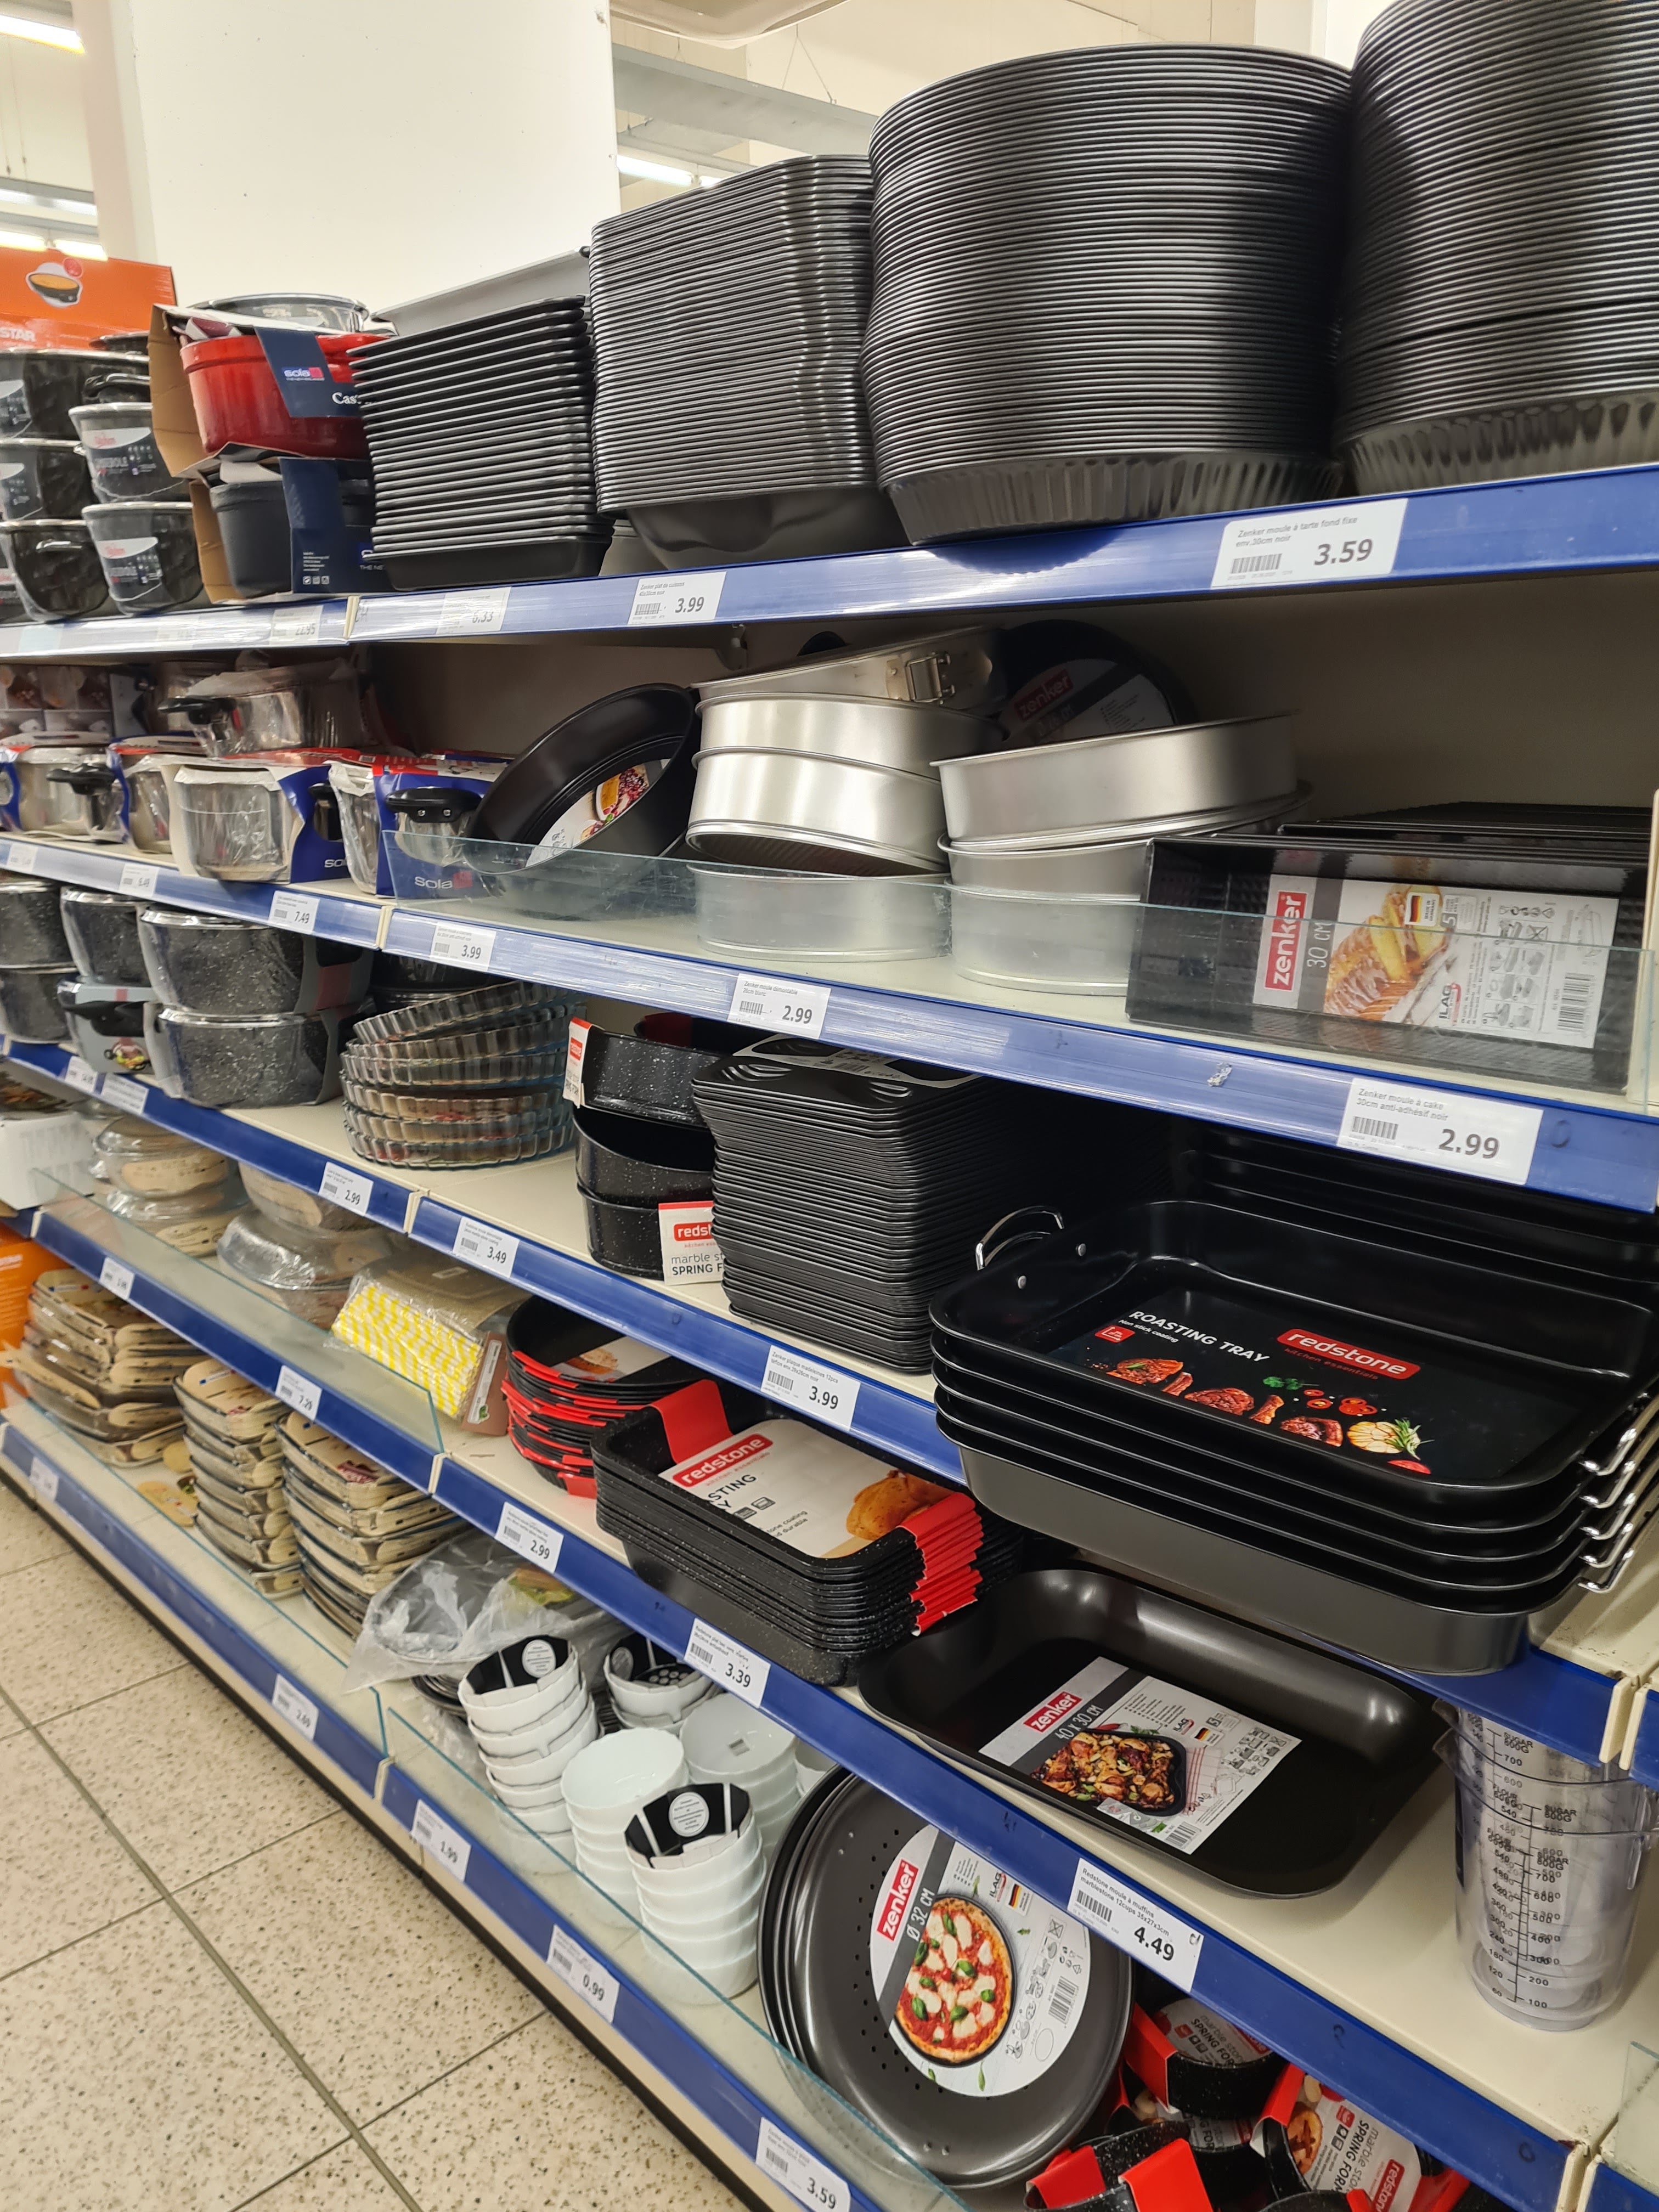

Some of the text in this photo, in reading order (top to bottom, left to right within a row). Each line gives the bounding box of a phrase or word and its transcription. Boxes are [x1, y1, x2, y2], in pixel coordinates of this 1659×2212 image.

[284, 368, 311, 377] sola
[1238, 516, 1358, 538] Zenker moule à tarte fond fixe
[1274, 535, 1291, 543] noir
[1313, 538, 1373, 566] 3.59
[675, 596, 704, 613] 3.99
[1019, 675, 1070, 719] zenker
[415, 876, 453, 890] sola
[1272, 895, 1302, 986] zenker
[1307, 922, 1333, 968] 30 CM
[461, 945, 482, 960] 3.99
[1439, 985, 1453, 1019] ILAG
[782, 1005, 812, 1024] 2.99
[1356, 1098, 1448, 1122] 30cm anti-adhésif noir
[1358, 1088, 1444, 1110] Zenker moule à cake
[1438, 1128, 1500, 1159] 2.99
[345, 1189, 360, 1205] 2.99
[487, 1246, 506, 1263] 3.49
[671, 1252, 710, 1265] marble
[672, 1263, 713, 1276] SPRING
[1128, 1311, 1270, 1362] ROASTING TRAY
[1133, 1322, 1153, 1333] stick
[1152, 1329, 1180, 1344] coating
[772, 1351, 787, 1362] Zenker
[786, 1357, 801, 1368] plaque
[1284, 1347, 1379, 1380] kitchen essentials
[1287, 1334, 1407, 1374] redstone
[809, 1386, 839, 1409] 3.99
[681, 1438, 765, 1485] redstone
[782, 1517, 809, 1533] durable
[531, 1539, 551, 1560] 2.99
[725, 1662, 752, 1688] 3.39
[1030, 1692, 1079, 1731] zenker
[1054, 1704, 1104, 1740] 40 x 30 CM
[1504, 1755, 1523, 1767] 700
[1504, 1776, 1523, 1788] 600
[1501, 1805, 1517, 1819] 540
[1544, 1804, 1577, 1816] SUGAR
[882, 1862, 915, 1937] zenker
[1082, 1867, 1109, 1889] Redstone
[1109, 1885, 1127, 1900] moule
[1132, 1900, 1155, 1918] muffins
[906, 1887, 935, 1942] Ø 32 CM
[1080, 1876, 1115, 1901] marblestone
[1115, 1898, 1136, 1915] 12cups
[1136, 1911, 1170, 1937] 35x27x3cm
[1533, 1914, 1553, 1925] 500
[1133, 1926, 1175, 1961] 4.49
[1531, 1934, 1551, 1945] 400
[1489, 1948, 1504, 1962] 180
[1488, 1965, 1503, 1979] 120
[1528, 1976, 1549, 1987] 200
[583, 1974, 605, 2002] 0.99
[1491, 1987, 1502, 1997] 60
[1528, 1999, 1548, 2009] 100
[1190, 2018, 1221, 2048] SPRING
[1346, 2119, 1370, 2162] SPRING
[1357, 2127, 1379, 2168] marble
[807, 2176, 837, 2210] 3.59
